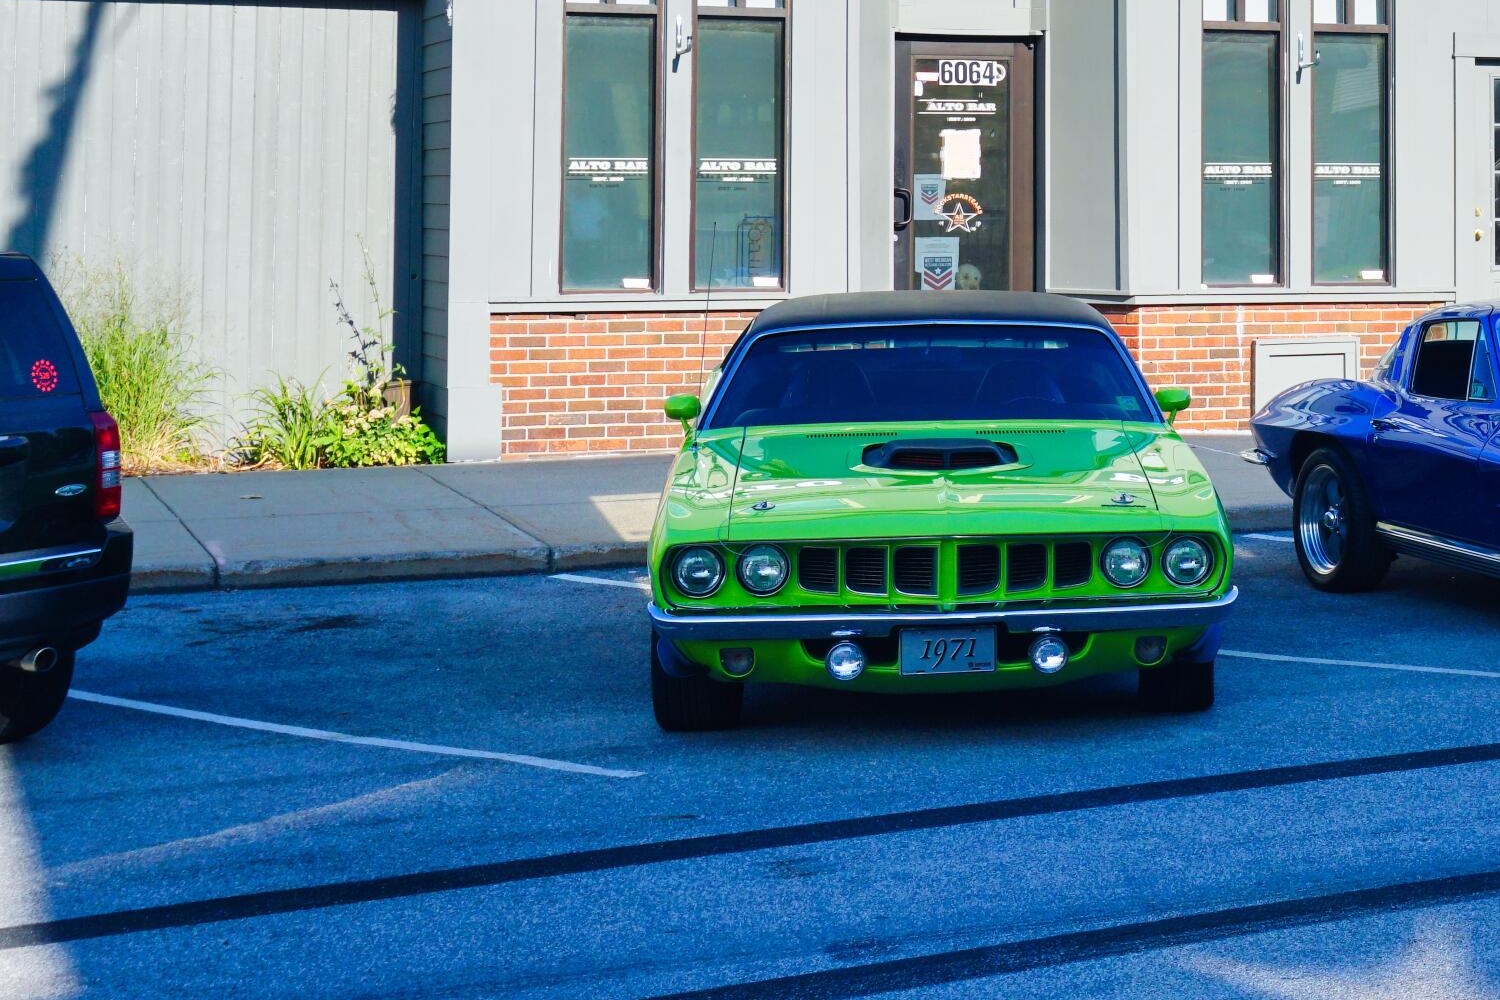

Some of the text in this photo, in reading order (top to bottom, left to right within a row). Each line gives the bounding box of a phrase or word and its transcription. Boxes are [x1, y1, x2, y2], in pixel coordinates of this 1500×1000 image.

[941, 61, 995, 85] 6064
[926, 102, 997, 112] ALTO BAR
[568, 160, 648, 170] ALTO BAR
[699, 161, 777, 171] ALTO BAR
[1203, 165, 1273, 174] ALTO BAR
[1314, 165, 1381, 175] ALTO BAR
[919, 638, 977, 670] 1971
